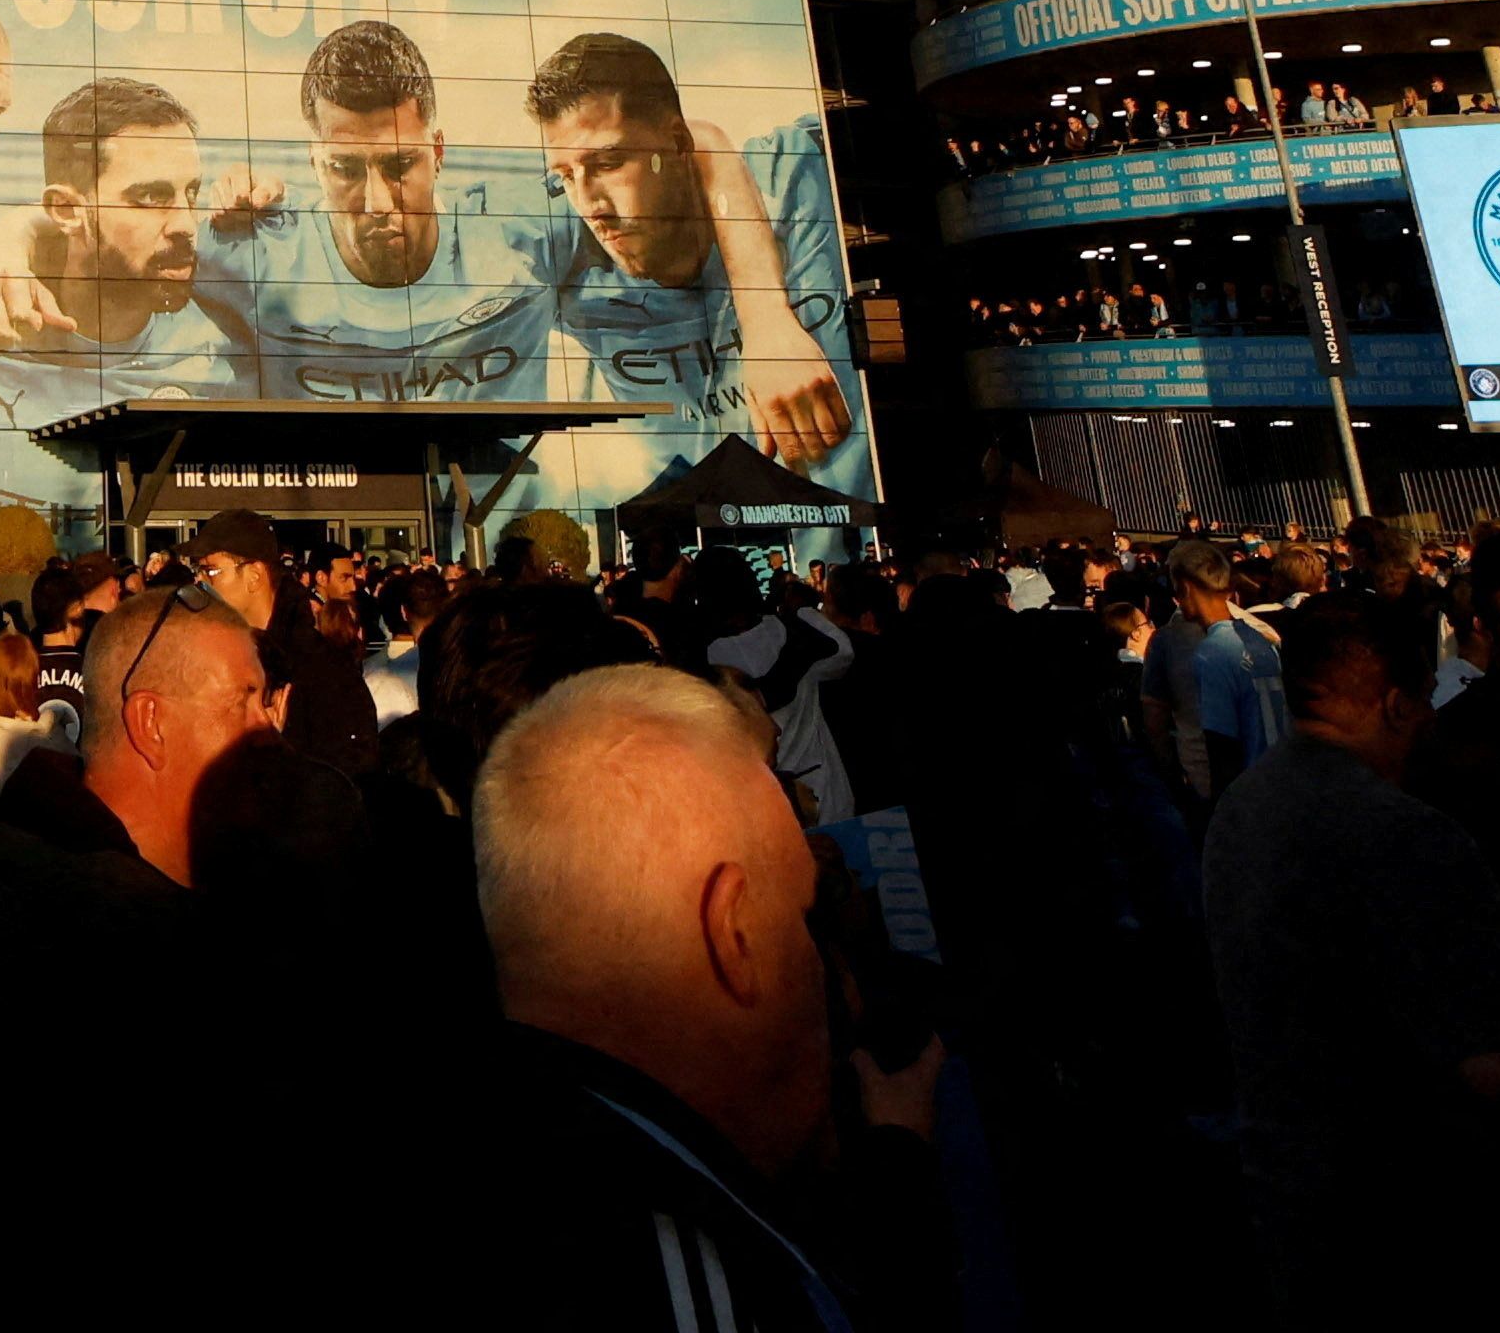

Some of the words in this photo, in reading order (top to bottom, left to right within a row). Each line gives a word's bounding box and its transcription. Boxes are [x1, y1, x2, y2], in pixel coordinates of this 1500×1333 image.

[1302, 143, 1337, 160] LYMM
[1331, 159, 1369, 176] METRO
[1303, 236, 1321, 278] WEST
[1312, 281, 1341, 364] RECEPTION
[294, 344, 519, 403] ETIHAD
[175, 462, 206, 488] THE
[209, 462, 259, 488] COLIN
[264, 462, 304, 488] BELL
[305, 462, 359, 488] STAND
[741, 503, 823, 525] MANCHESTER
